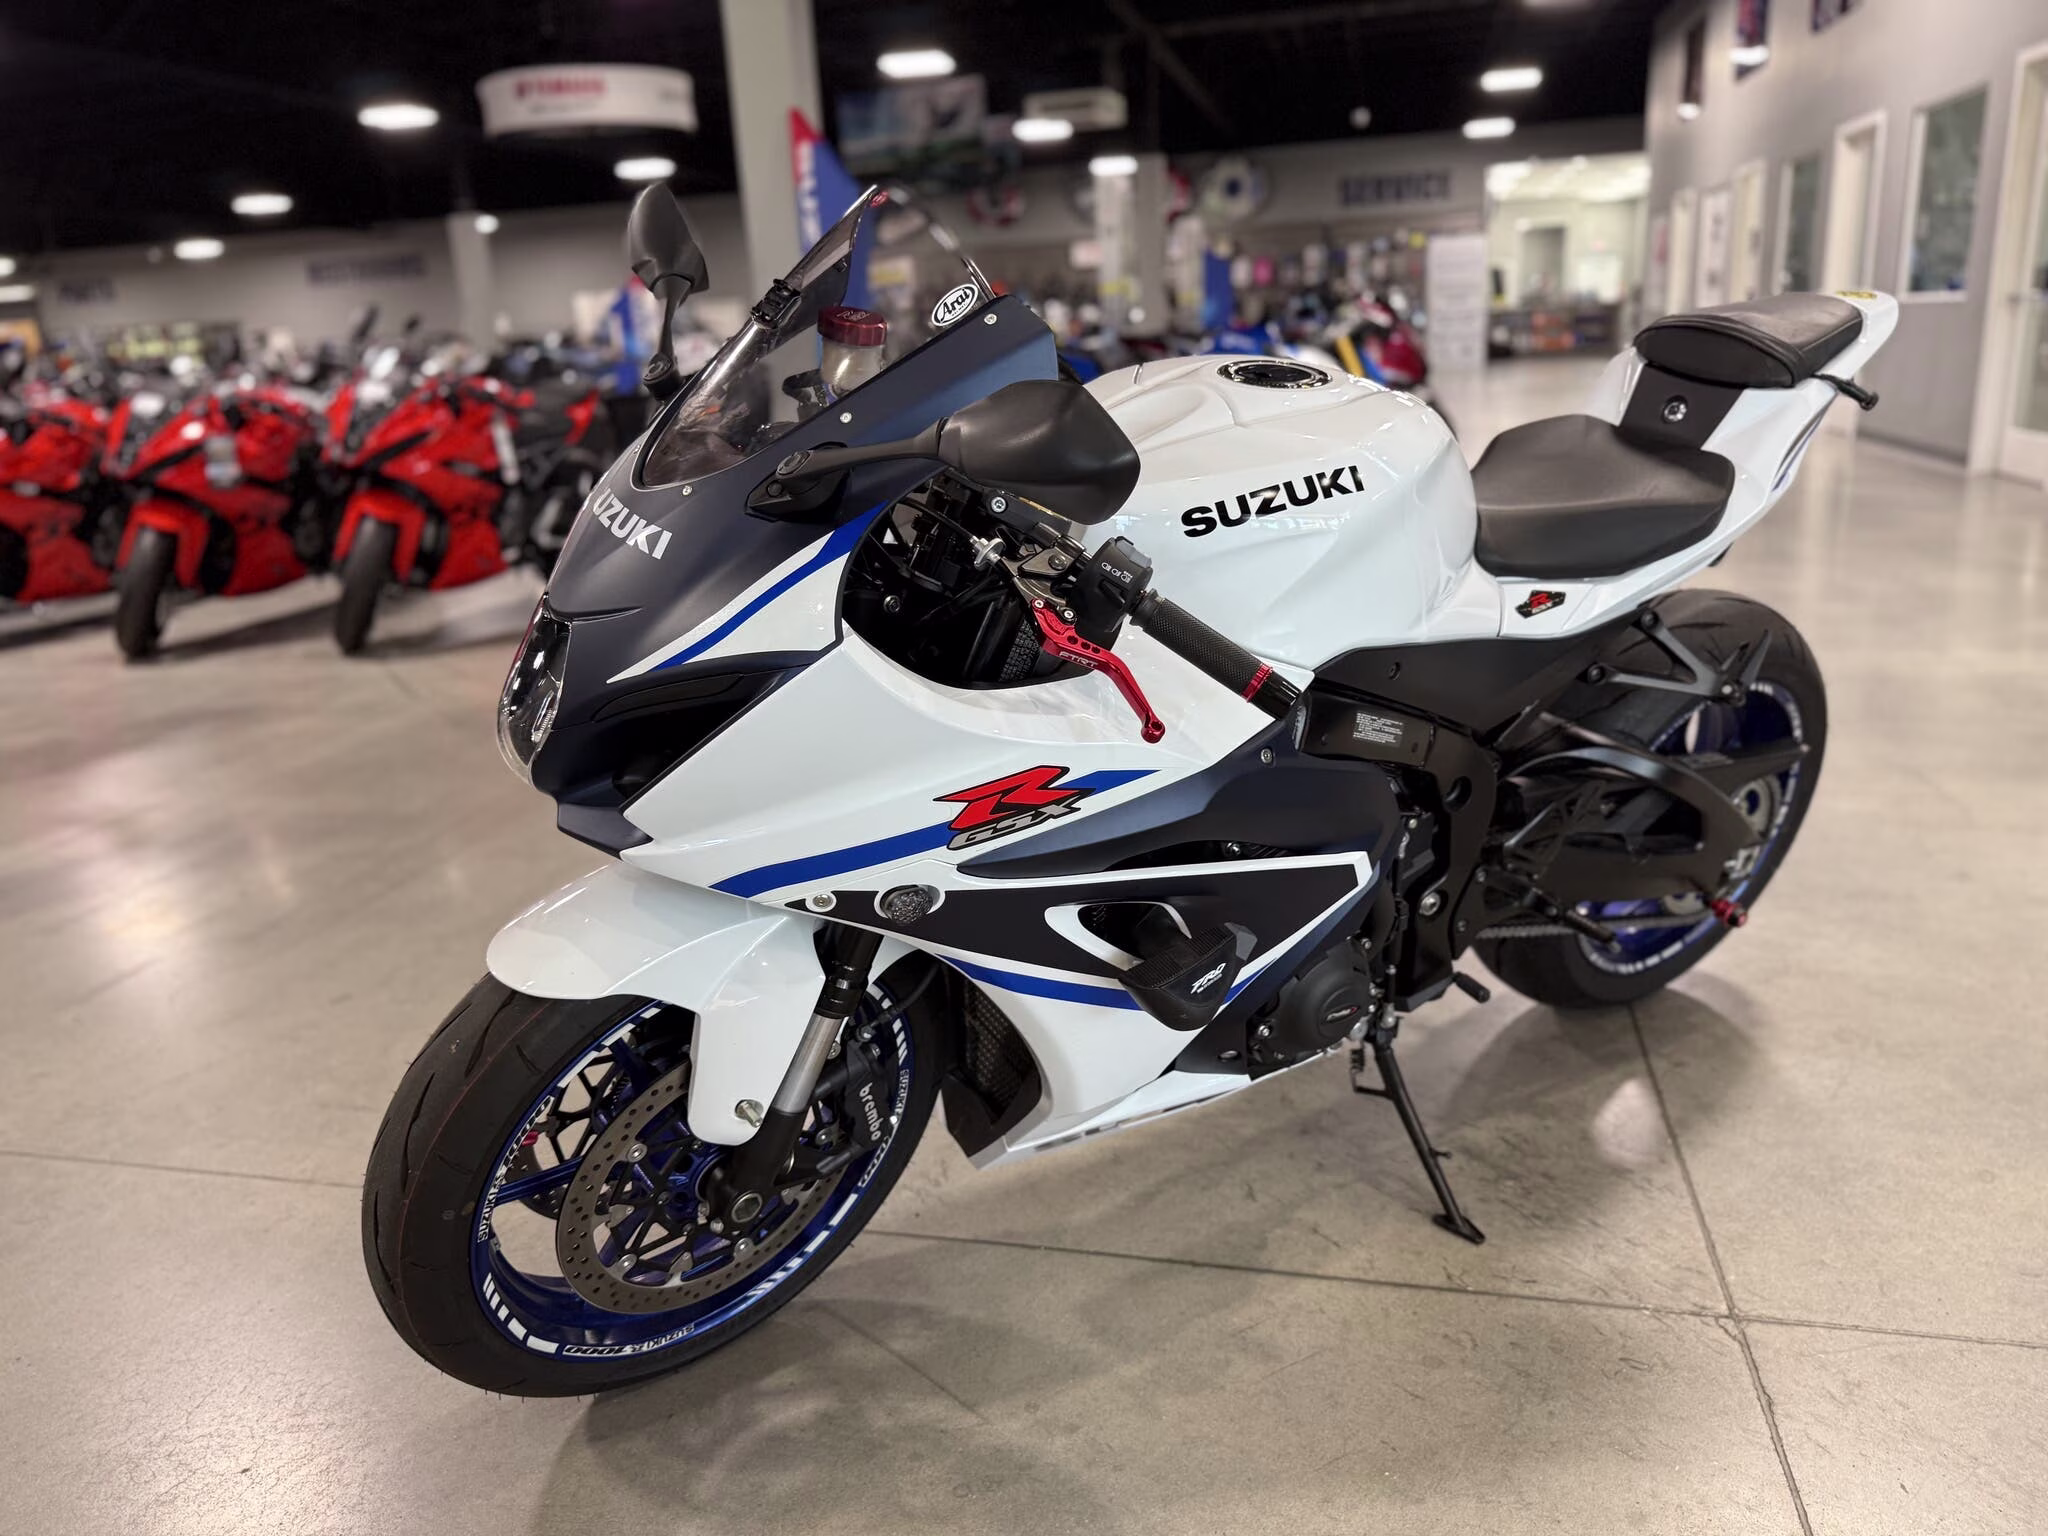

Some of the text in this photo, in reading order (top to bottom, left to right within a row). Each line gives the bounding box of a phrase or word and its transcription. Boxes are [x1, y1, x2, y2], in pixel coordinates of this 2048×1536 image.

[940, 288, 970, 322] Arai
[593, 488, 673, 560] UZUKI
[1181, 465, 1365, 538] SUZUKI
[947, 793, 1081, 850] GSX
[859, 1082, 884, 1141] brembo
[479, 1191, 498, 1242] SUZUKI
[563, 1344, 631, 1357] 1000
[645, 1322, 696, 1350] SUZUKI
